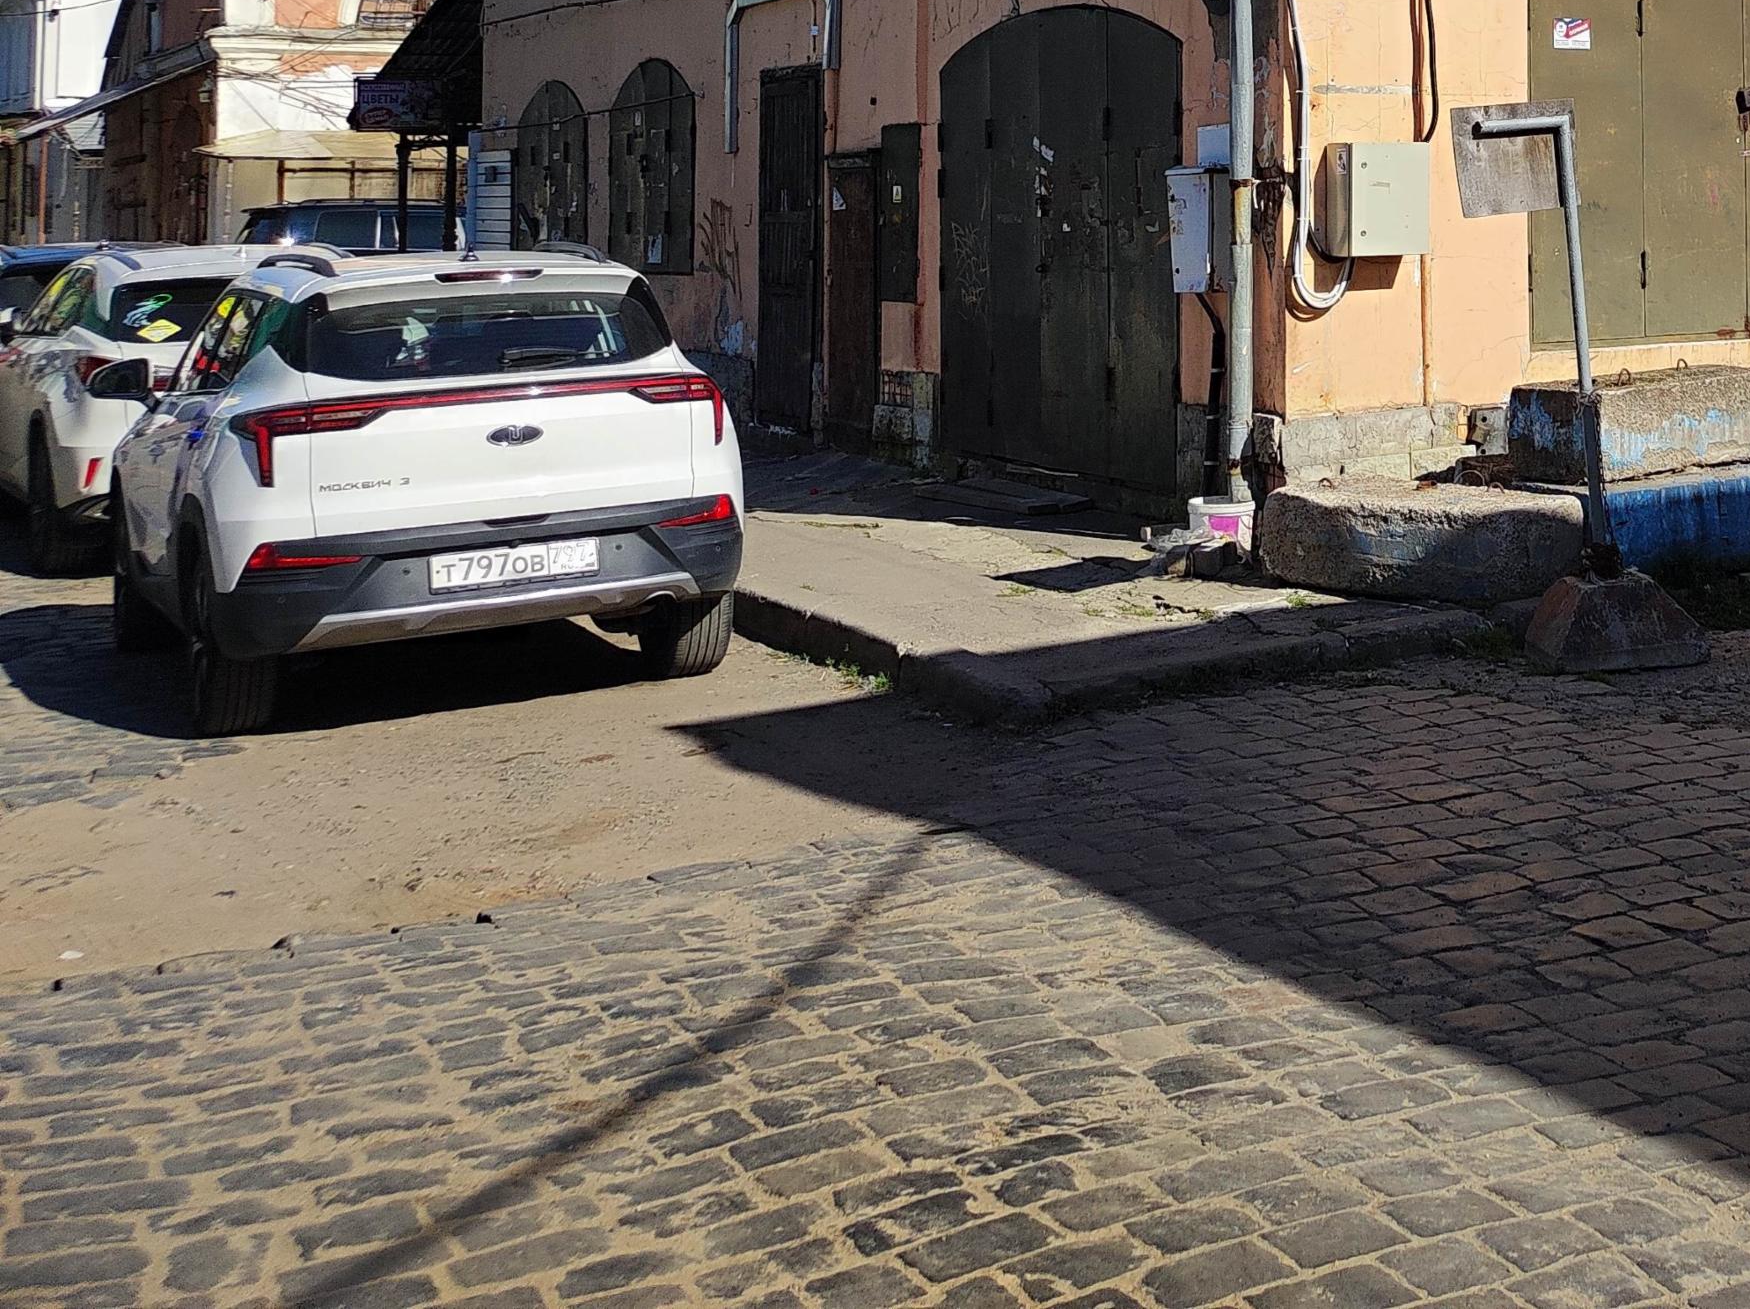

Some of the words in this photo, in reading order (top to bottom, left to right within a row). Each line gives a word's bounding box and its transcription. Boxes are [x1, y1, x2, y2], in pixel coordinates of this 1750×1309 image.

[362, 93, 399, 105] ЦВЕТЫ
[319, 479, 392, 493] МОСКВИЧ
[399, 477, 411, 487] 3
[440, 553, 546, 583] Т797ОВ
